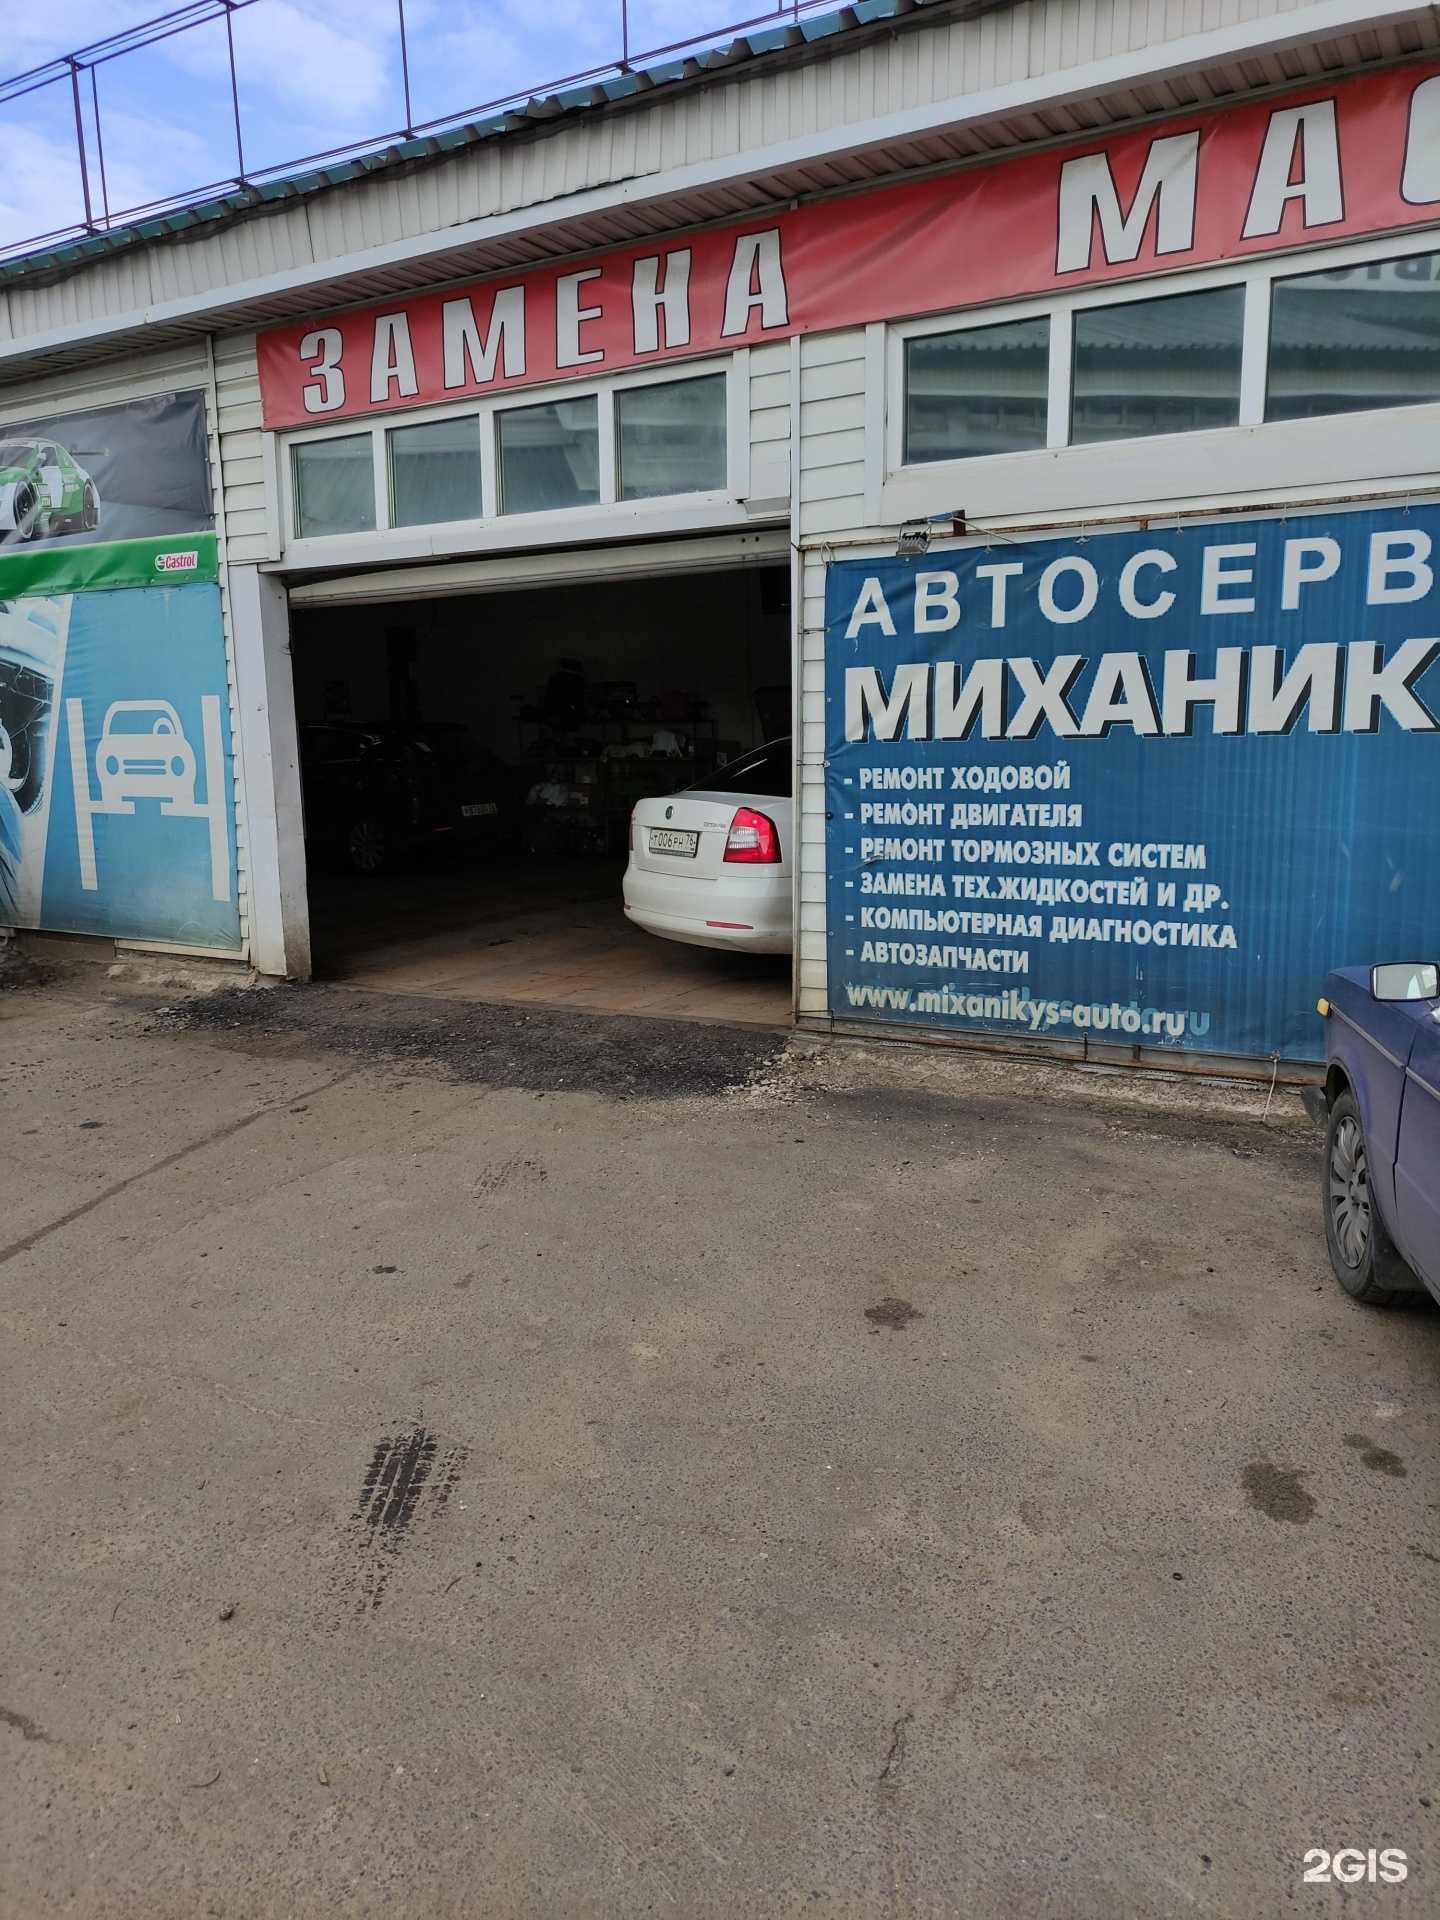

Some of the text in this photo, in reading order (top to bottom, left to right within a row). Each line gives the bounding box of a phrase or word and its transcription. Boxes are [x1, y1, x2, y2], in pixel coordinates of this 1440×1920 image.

[299, 227, 789, 414] ЗАМЕНА
[165, 554, 195, 569] Castrol
[844, 529, 1433, 640] АВТОСЕРВ
[844, 637, 1440, 743] МИХАНИК
[860, 760, 1071, 793] РЕМОНТ ХОДОВОЙ
[860, 802, 1082, 830] РЕМОНТ ДВИГАТЕЛЯ
[860, 837, 1206, 869] РЕМОНТ ТОРМОЗНЫХ СИСТЕМ
[860, 872, 946, 897] ЗАМЕНА
[1157, 882, 1176, 907] И
[1183, 883, 1229, 913] ДР.
[860, 906, 1239, 949] КОМПЬЮТЕРНАЯ ДИАГНОСТИКА
[860, 941, 1029, 974] АВТОЗАПЧАСТИ
